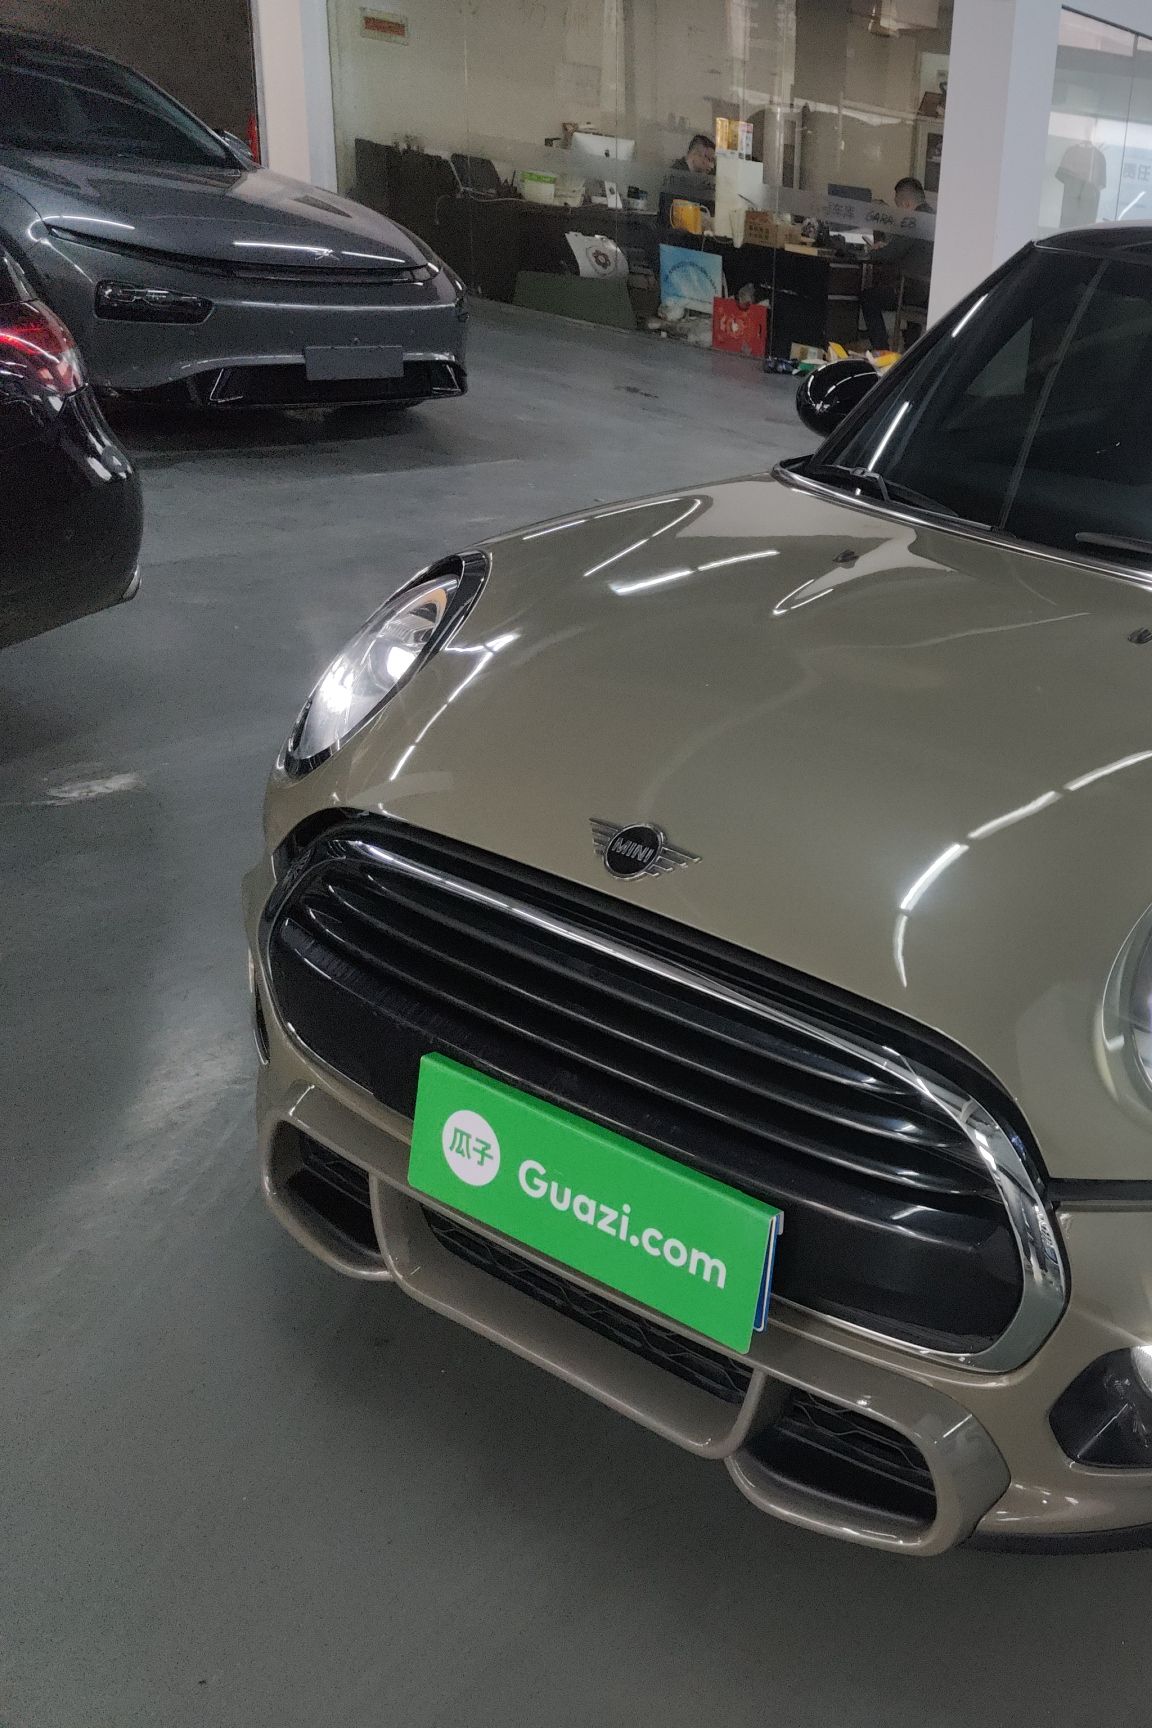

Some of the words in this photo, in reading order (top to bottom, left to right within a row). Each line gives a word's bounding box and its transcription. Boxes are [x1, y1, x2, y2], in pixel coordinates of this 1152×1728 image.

[611, 837, 655, 863] MINI
[449, 1127, 494, 1167] 瓜子
[518, 1159, 727, 1289] Guazi.com
